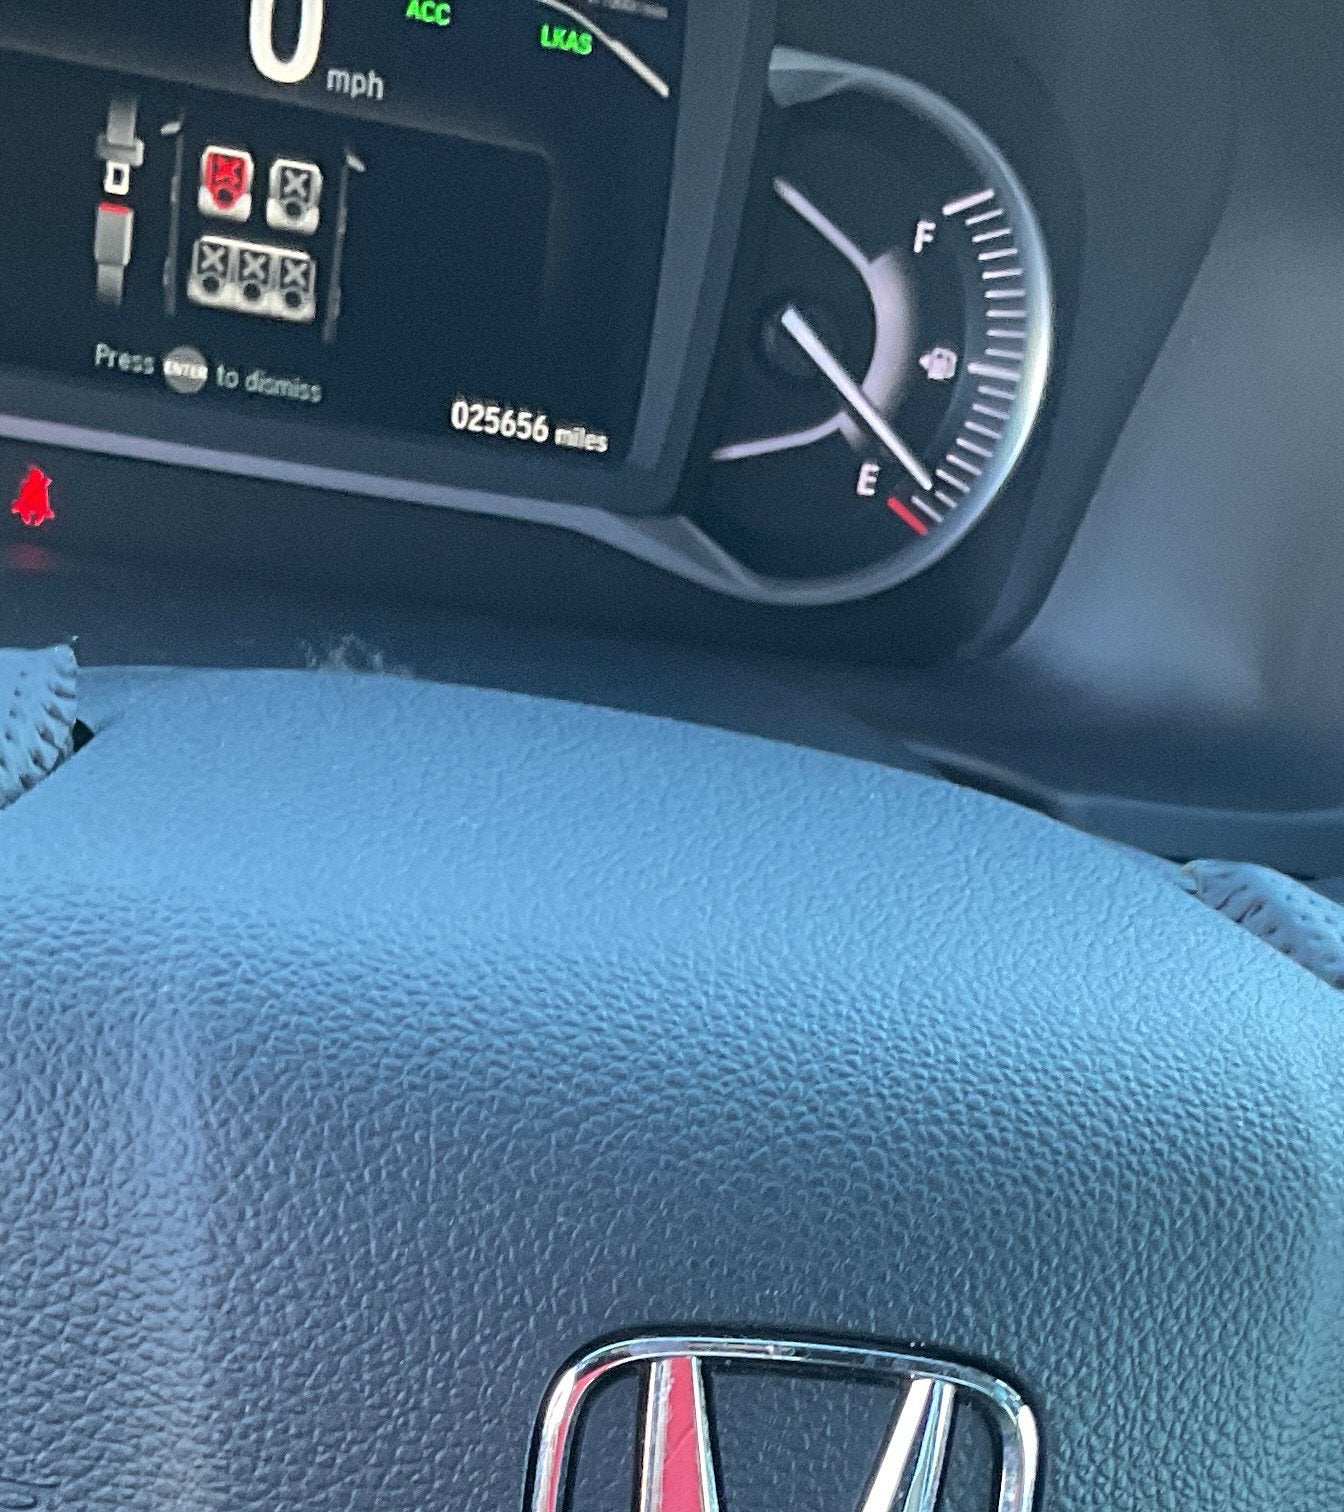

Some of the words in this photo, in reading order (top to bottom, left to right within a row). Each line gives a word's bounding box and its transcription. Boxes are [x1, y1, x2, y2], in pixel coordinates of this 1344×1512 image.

[405, 0, 452, 27] ACC
[539, 23, 593, 56] LKAS
[325, 67, 385, 100] mph
[913, 218, 937, 254] F
[93, 342, 154, 376] Press
[216, 363, 240, 389] to
[450, 399, 549, 444] 025656
[554, 423, 609, 455] miles
[856, 462, 881, 496] E
